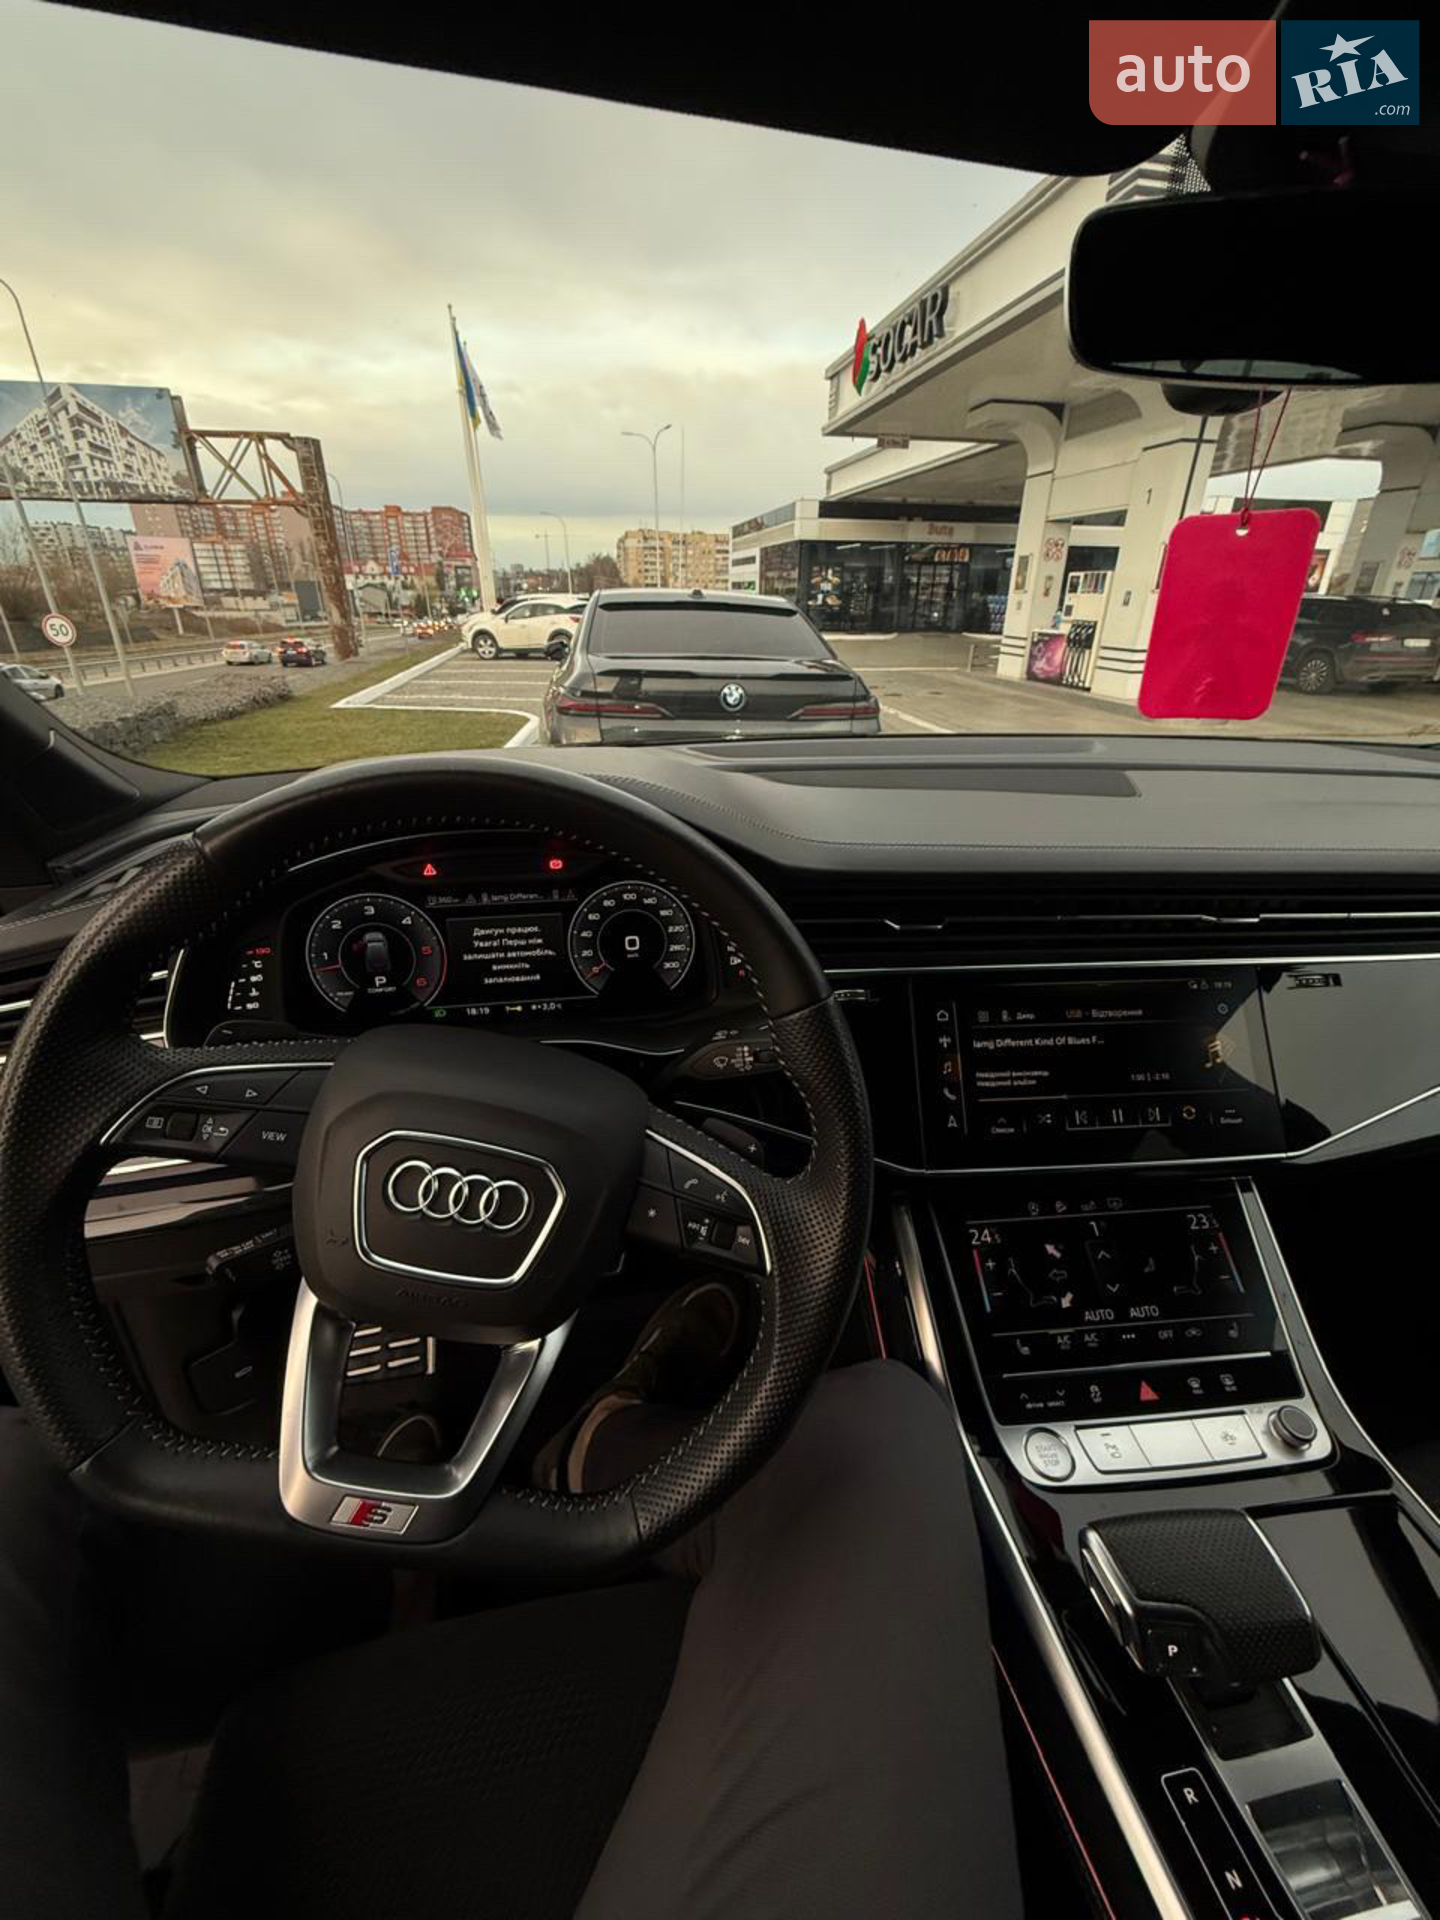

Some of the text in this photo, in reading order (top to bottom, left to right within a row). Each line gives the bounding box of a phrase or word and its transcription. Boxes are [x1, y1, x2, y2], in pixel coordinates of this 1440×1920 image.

[868, 283, 950, 383] SOCAR
[49, 623, 69, 637] 50
[364, 906, 375, 915] 3
[331, 920, 342, 929] 2
[401, 916, 412, 925] 4
[625, 935, 640, 951] 0
[322, 951, 328, 960] 1
[374, 976, 387, 987] P
[996, 1038, 1034, 1048] Different
[1034, 1037, 1054, 1046] Kind
[202, 1124, 212, 1133] OK
[261, 1131, 288, 1141] VIEW
[1187, 1214, 1210, 1229] 23
[968, 1228, 991, 1245] 24
[1084, 1309, 1115, 1321] AUTO
[1130, 1306, 1160, 1318] AUTO
[1168, 1645, 1178, 1656] P
[1183, 1787, 1199, 1804] R
[1225, 1870, 1243, 1890] N
